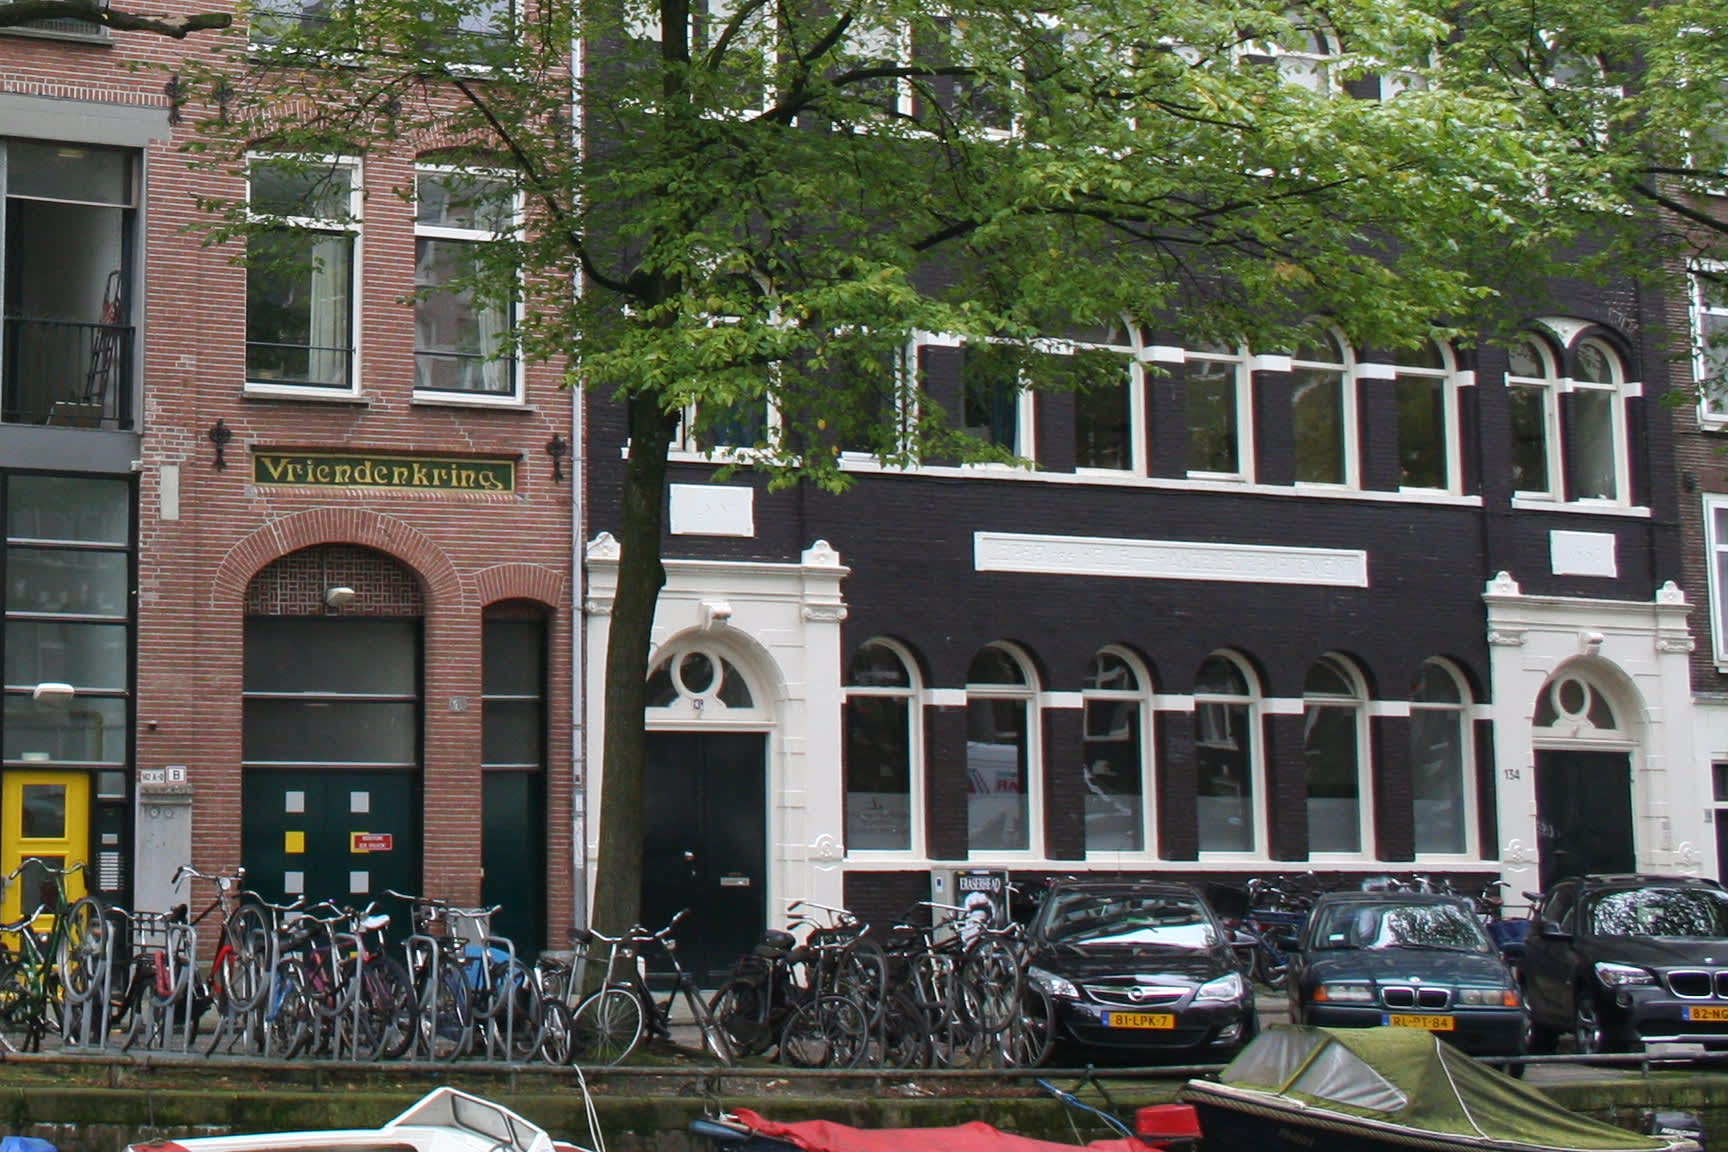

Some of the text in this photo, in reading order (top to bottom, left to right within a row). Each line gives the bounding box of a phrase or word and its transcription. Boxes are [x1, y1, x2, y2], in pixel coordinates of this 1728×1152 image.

[260, 457, 503, 490] Vriendenkring
[173, 769, 180, 780] B
[1115, 1015, 1168, 1026] 81-LPK-7
